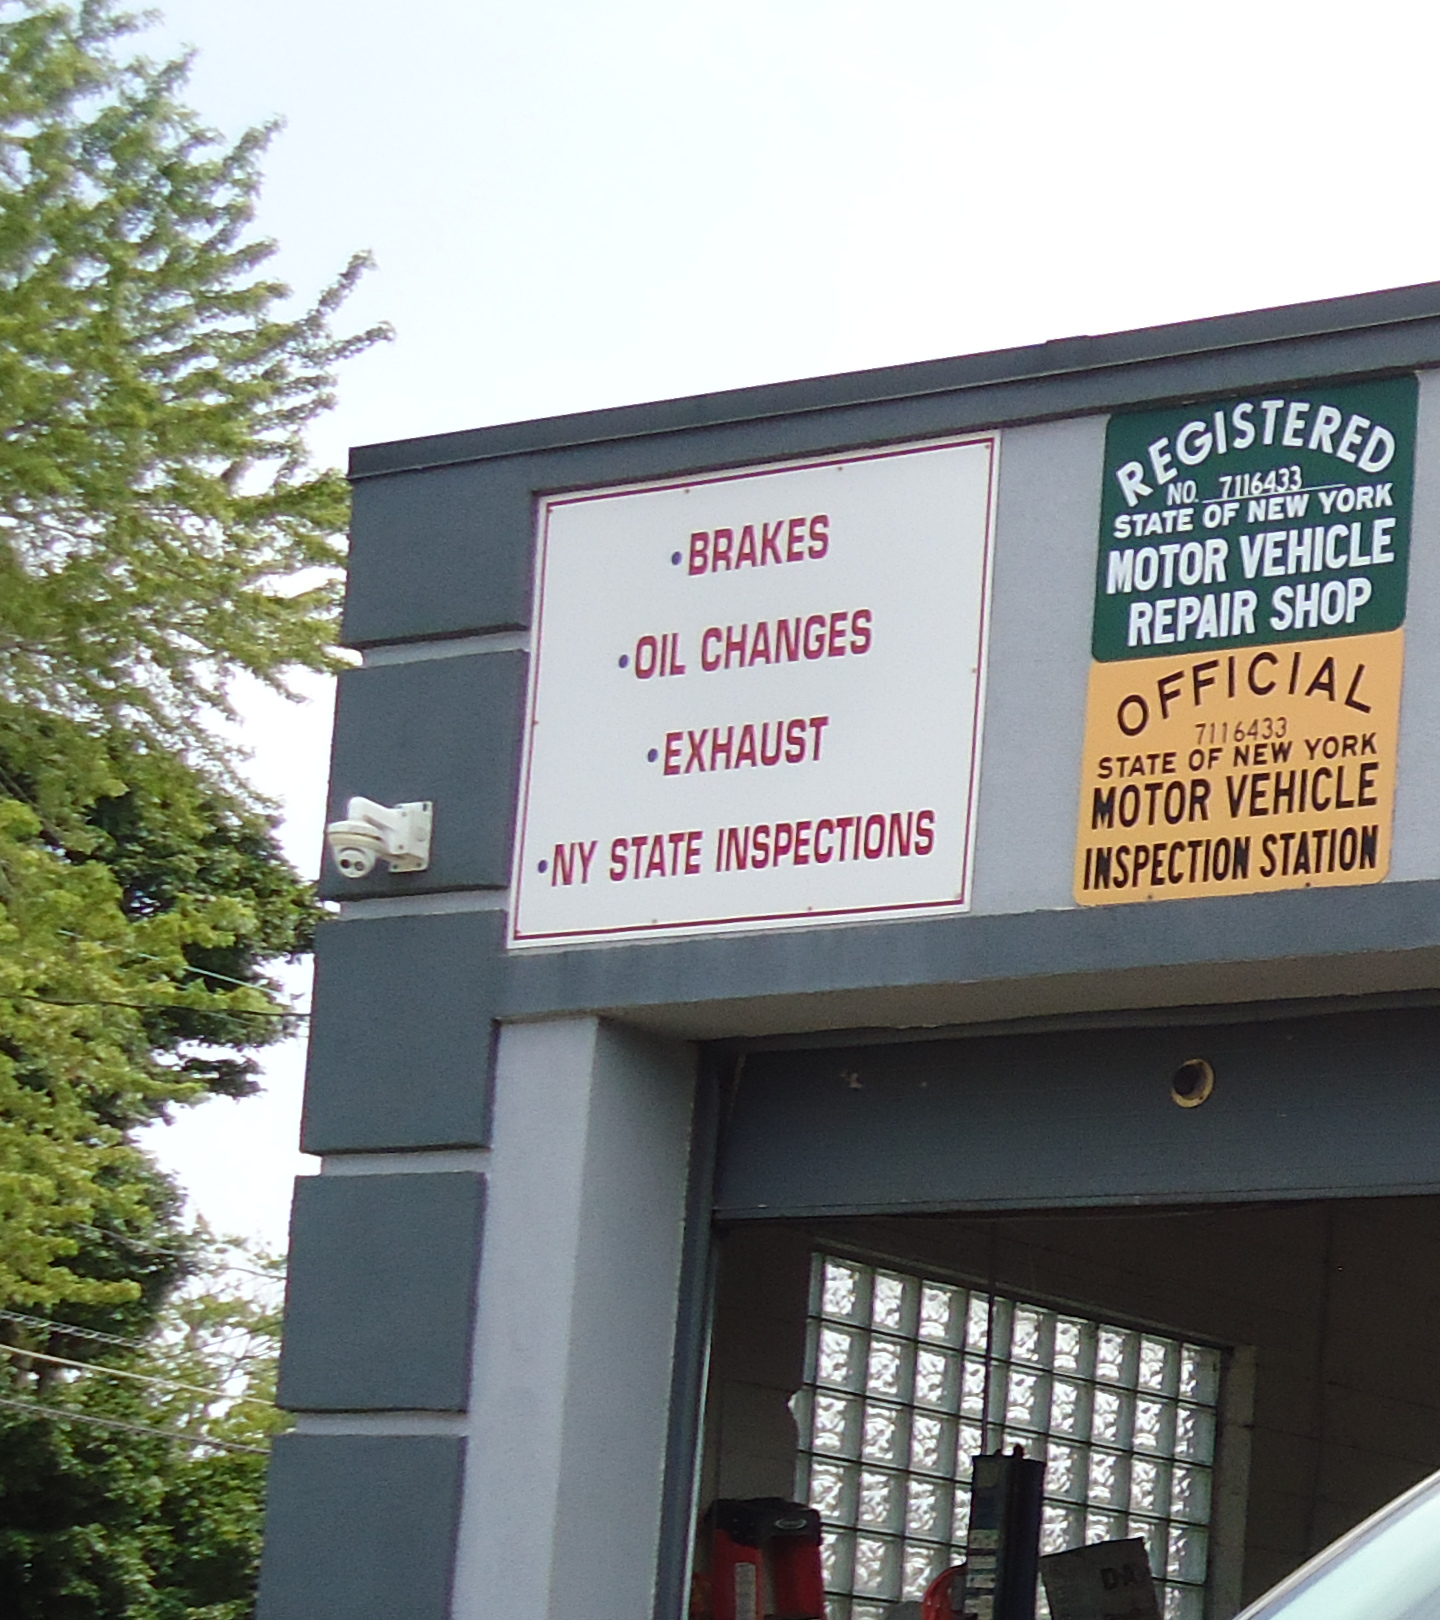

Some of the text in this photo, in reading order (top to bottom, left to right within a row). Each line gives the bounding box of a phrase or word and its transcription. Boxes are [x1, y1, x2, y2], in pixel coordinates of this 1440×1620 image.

[1116, 399, 1396, 507] REGISTERED
[1219, 465, 1302, 499] 7116433
[1114, 483, 1394, 538] STATE OF NEW YORK
[688, 514, 829, 576] BRAKES
[1106, 517, 1397, 594] MOTOR VEHICLE
[634, 608, 872, 679] OIL CHANGES
[1127, 577, 1372, 647] REPAIR SHOP
[1117, 651, 1372, 737] OFFICIAL
[663, 716, 829, 776] EXHAUST
[1097, 732, 1379, 779] STATE OF NEW YORK
[1195, 716, 1288, 744] 7116433
[1091, 762, 1379, 830] MOTOR VEHICLE
[551, 809, 936, 887] NY STATE INSPECTIONS
[1083, 824, 1379, 891] INSPECTION STATION
